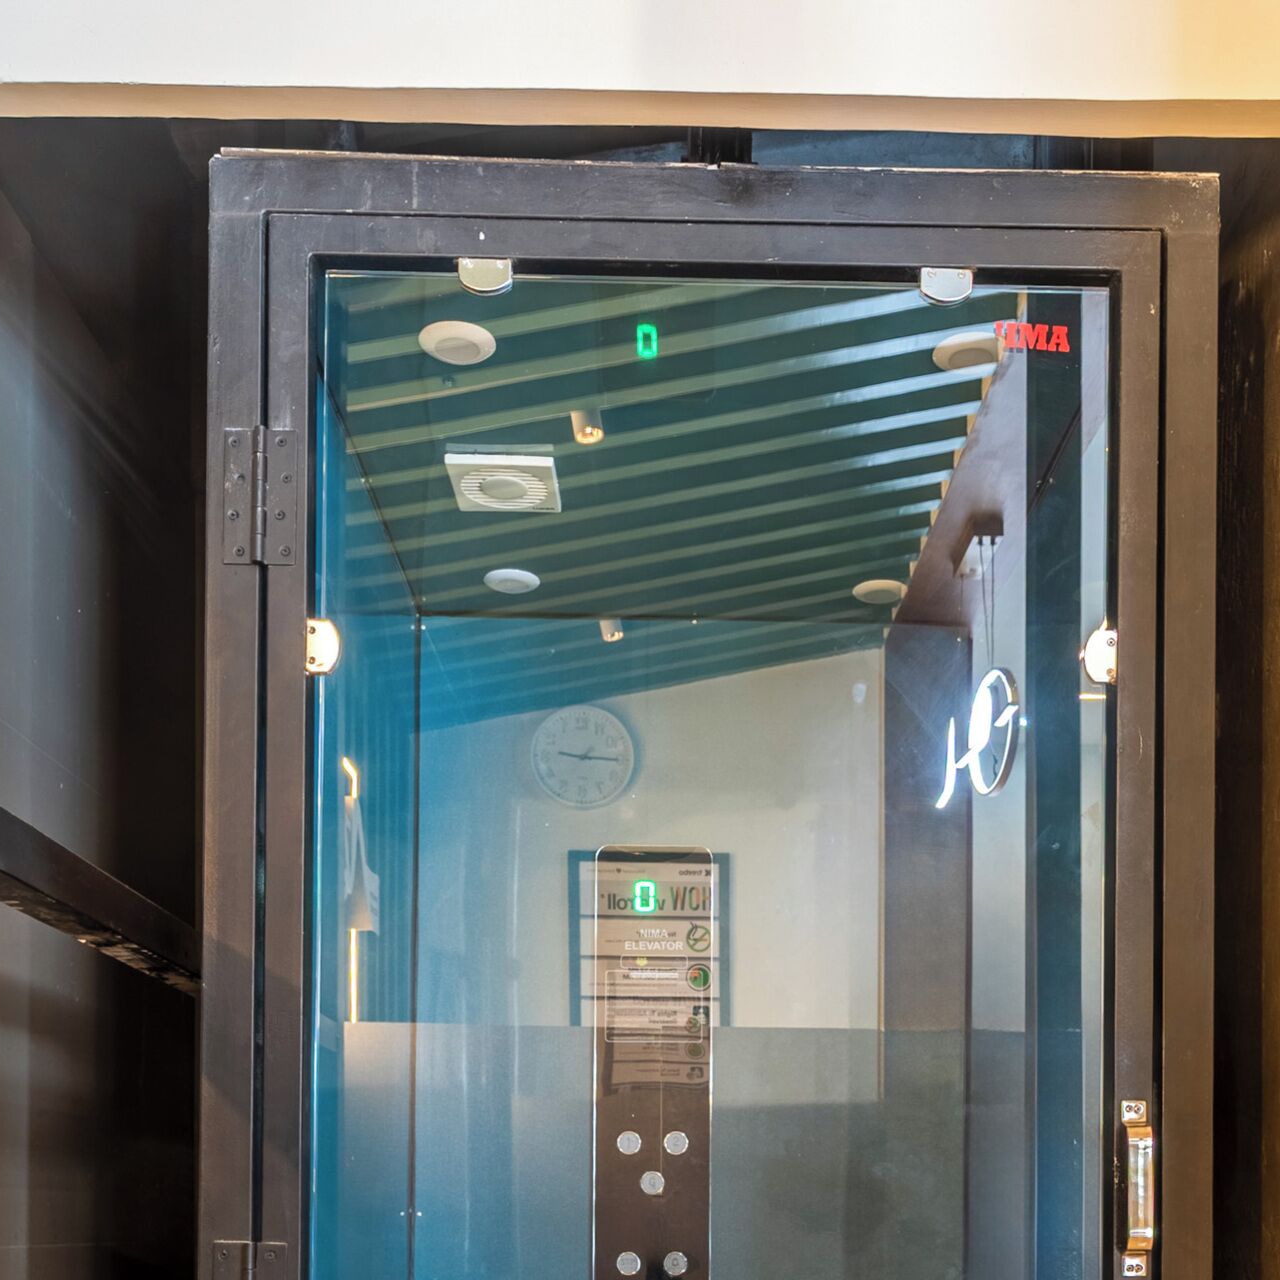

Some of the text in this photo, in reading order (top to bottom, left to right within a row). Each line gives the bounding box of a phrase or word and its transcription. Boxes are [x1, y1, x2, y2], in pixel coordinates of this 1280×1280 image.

[634, 880, 656, 912] 0
[639, 928, 668, 939] NIMA
[624, 940, 684, 951] ELEVATOR
